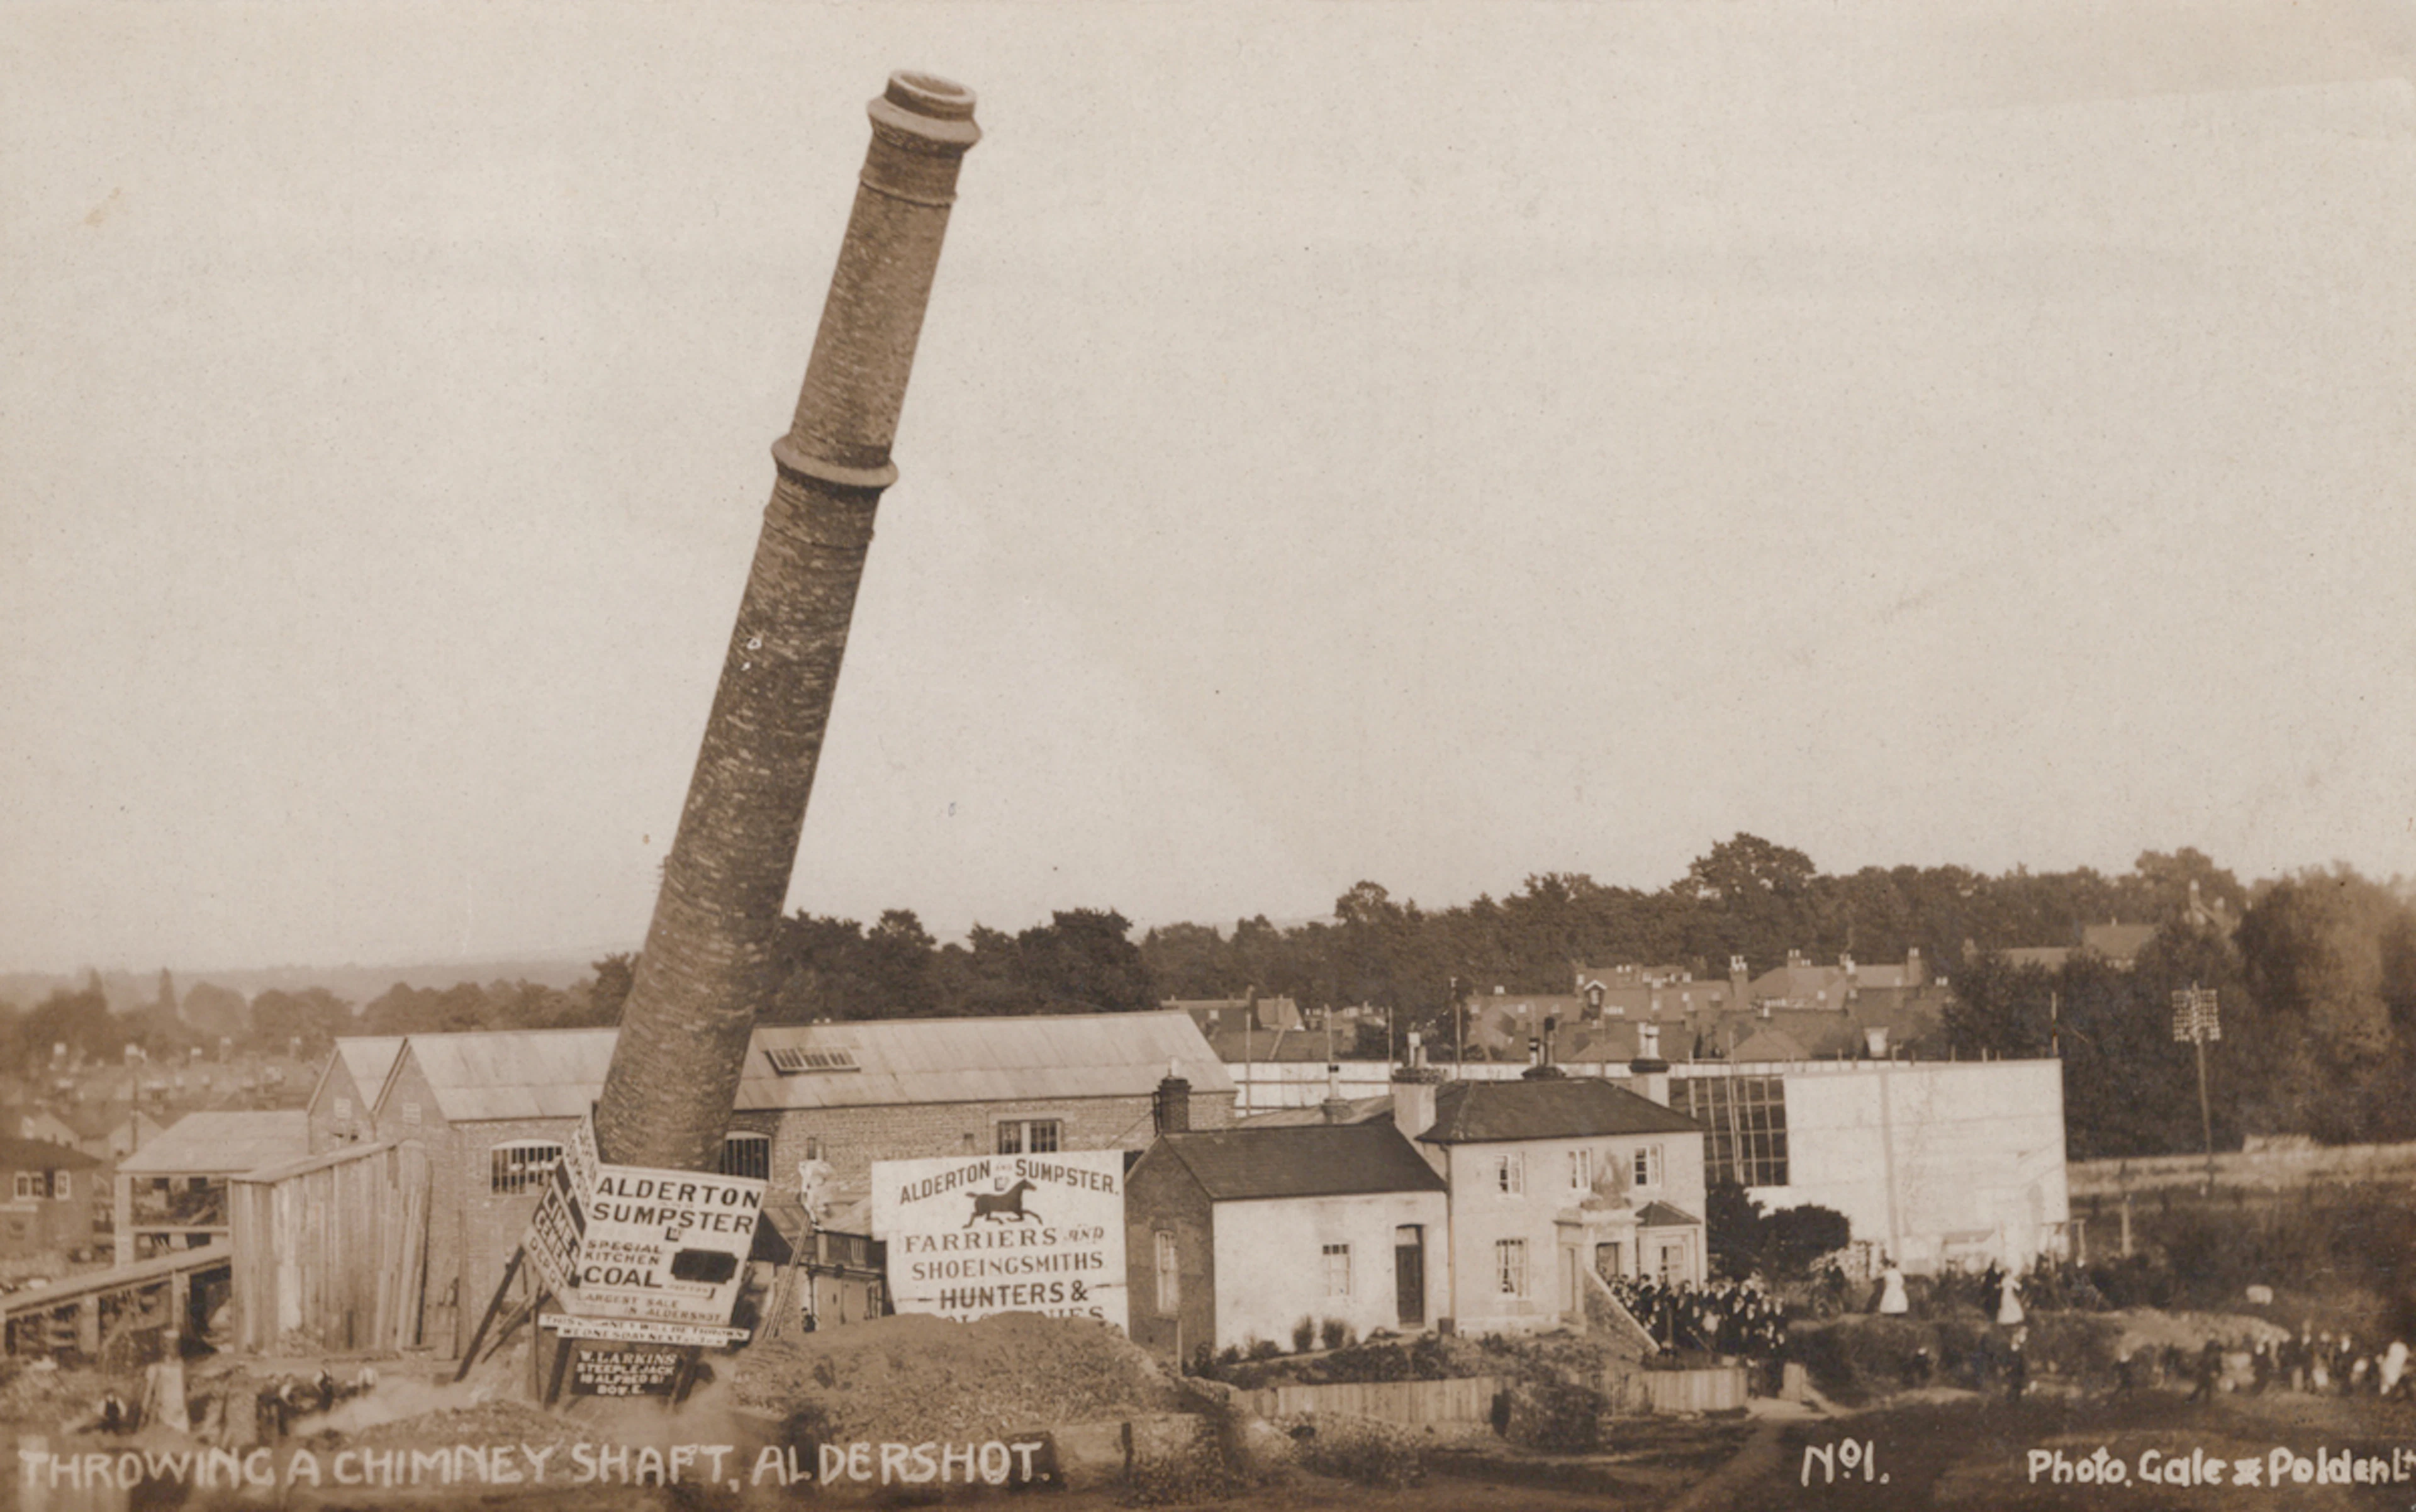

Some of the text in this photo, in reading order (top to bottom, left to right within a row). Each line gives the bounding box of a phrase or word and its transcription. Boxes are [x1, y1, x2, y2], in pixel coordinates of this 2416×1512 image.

[596, 1176, 761, 1209] ALDERTON
[900, 1160, 990, 1205] ALDERTON
[1015, 1158, 1119, 1196] SUMPSTER.
[592, 1202, 754, 1235] SUMPSTER
[588, 1240, 663, 1254] SPECIAL
[905, 1224, 1104, 1253] FARRIERS AND
[585, 1252, 660, 1265] KITCHEN
[912, 1252, 1103, 1281] SHOEINGSMITHS
[584, 1265, 663, 1289] COAL
[577, 1292, 639, 1304] LARGEST
[940, 1280, 1088, 1309] HUNTERS &
[645, 1309, 721, 1321] ALDERSHOT
[577, 1362, 674, 1375] STEEPLEJACK
[597, 1352, 678, 1365] LARKINS
